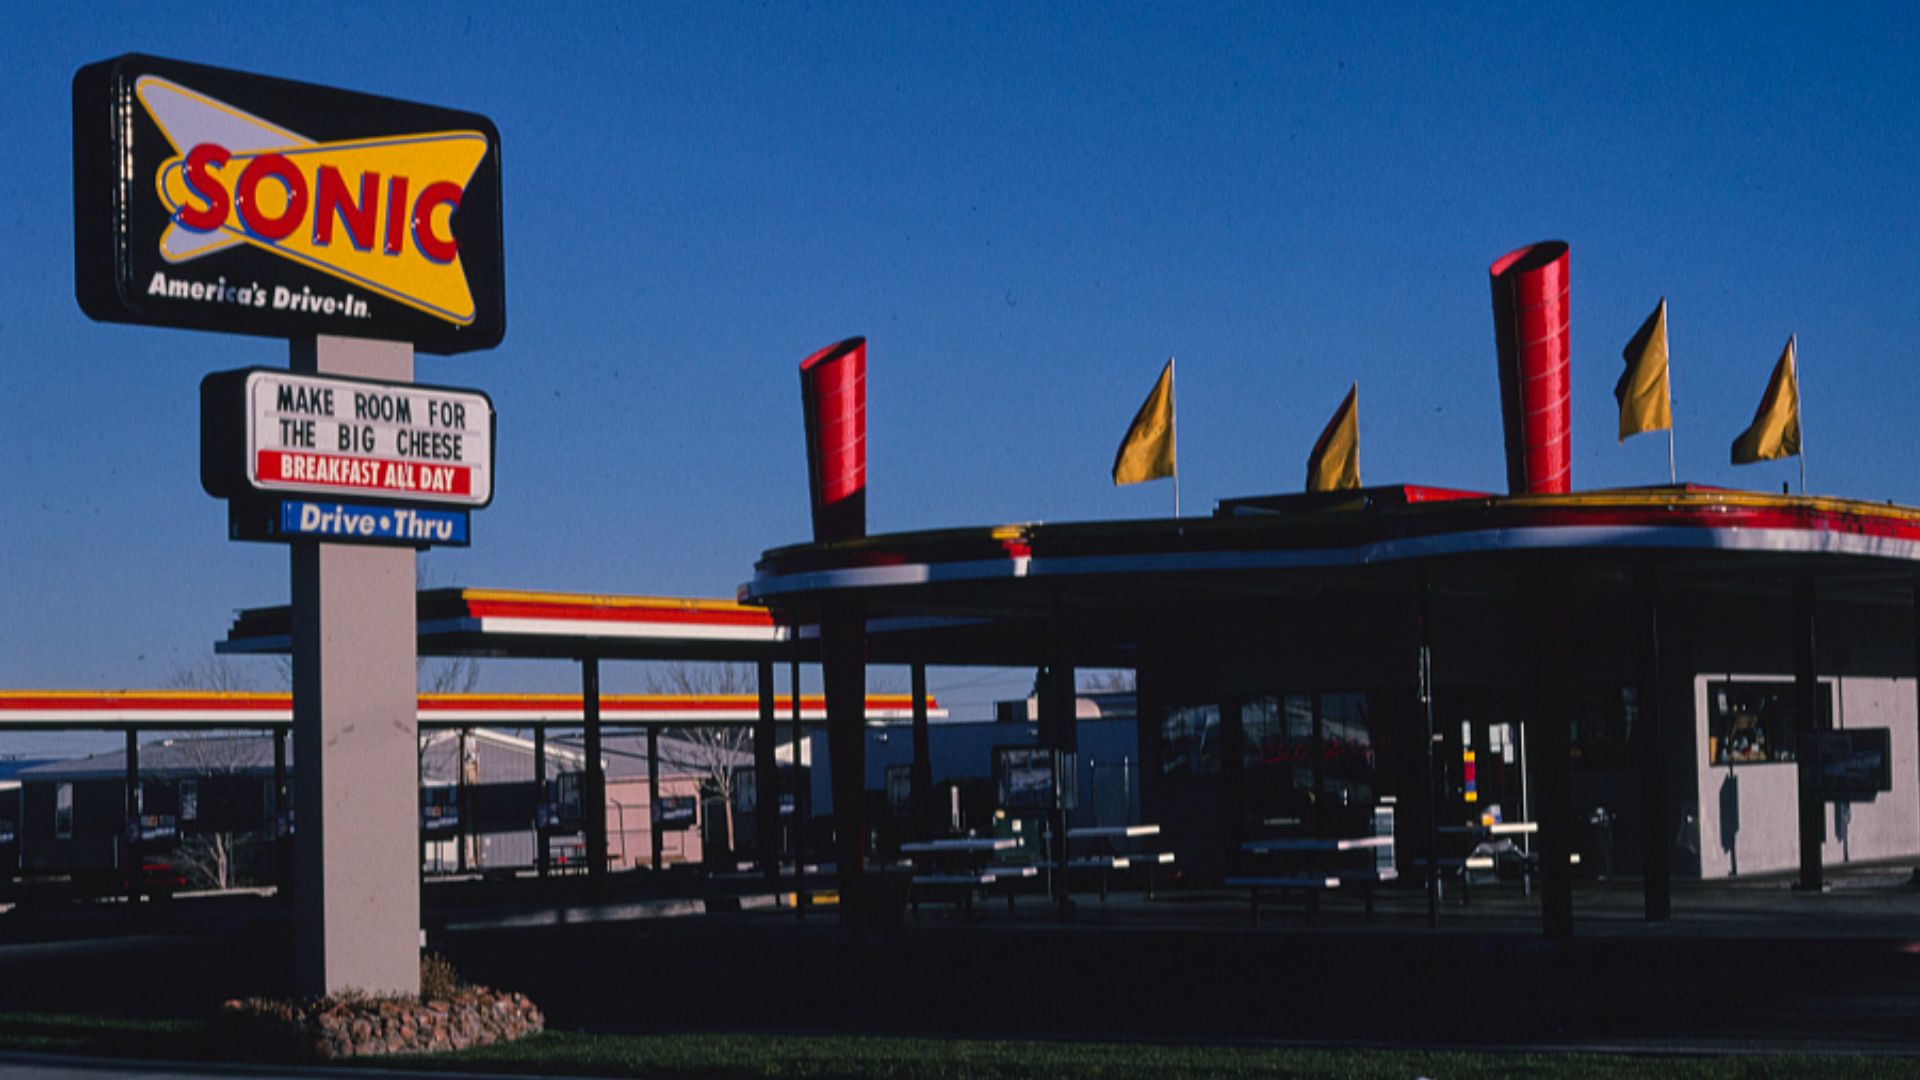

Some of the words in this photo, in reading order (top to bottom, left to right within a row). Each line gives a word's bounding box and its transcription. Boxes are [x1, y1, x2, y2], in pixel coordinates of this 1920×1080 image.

[171, 143, 463, 264] SONIC
[148, 271, 267, 307] America's
[277, 385, 334, 416] MAKE
[355, 393, 412, 423] ROOM
[429, 400, 466, 429] FOR
[279, 419, 316, 448] THE
[338, 426, 375, 453] BIG
[396, 429, 463, 461] CHEESE
[280, 454, 381, 486] BREAKFAST
[384, 463, 417, 490] ALL
[420, 467, 455, 492] DAY
